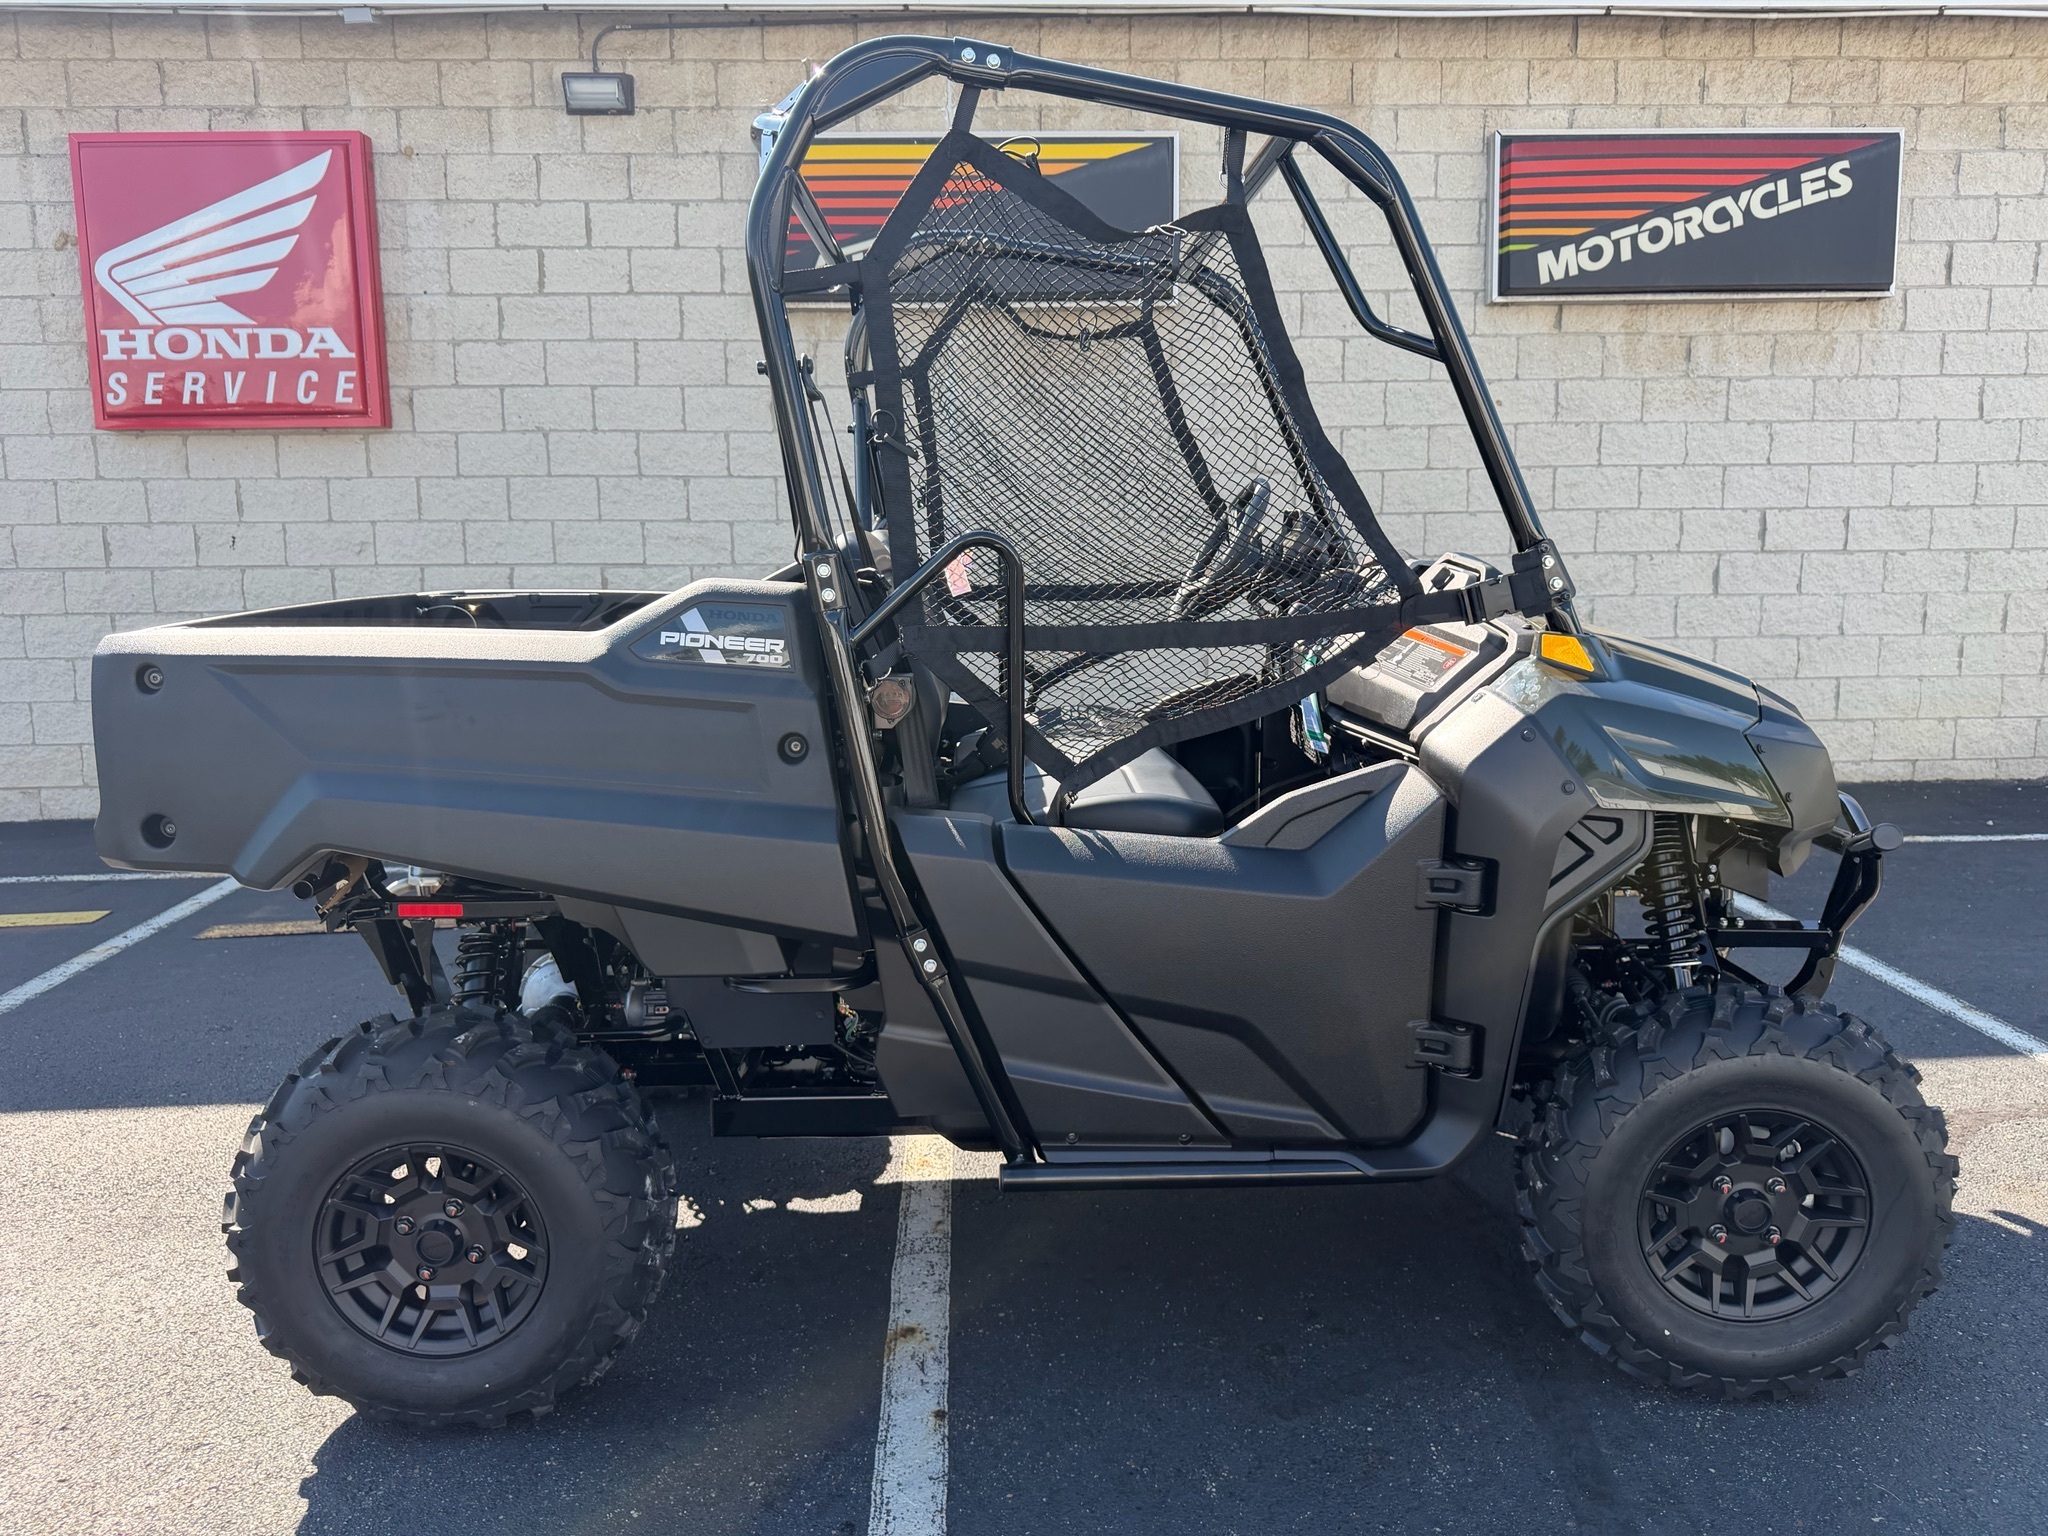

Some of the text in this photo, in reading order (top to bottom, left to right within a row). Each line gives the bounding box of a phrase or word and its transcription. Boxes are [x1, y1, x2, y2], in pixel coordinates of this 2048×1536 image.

[1537, 160, 1854, 285] MOTORCYCLES
[100, 328, 356, 361] HONDA
[106, 370, 357, 406] SERVICE
[708, 609, 779, 624] HONDA
[660, 631, 785, 653] PIONEER
[743, 653, 783, 664] 700
